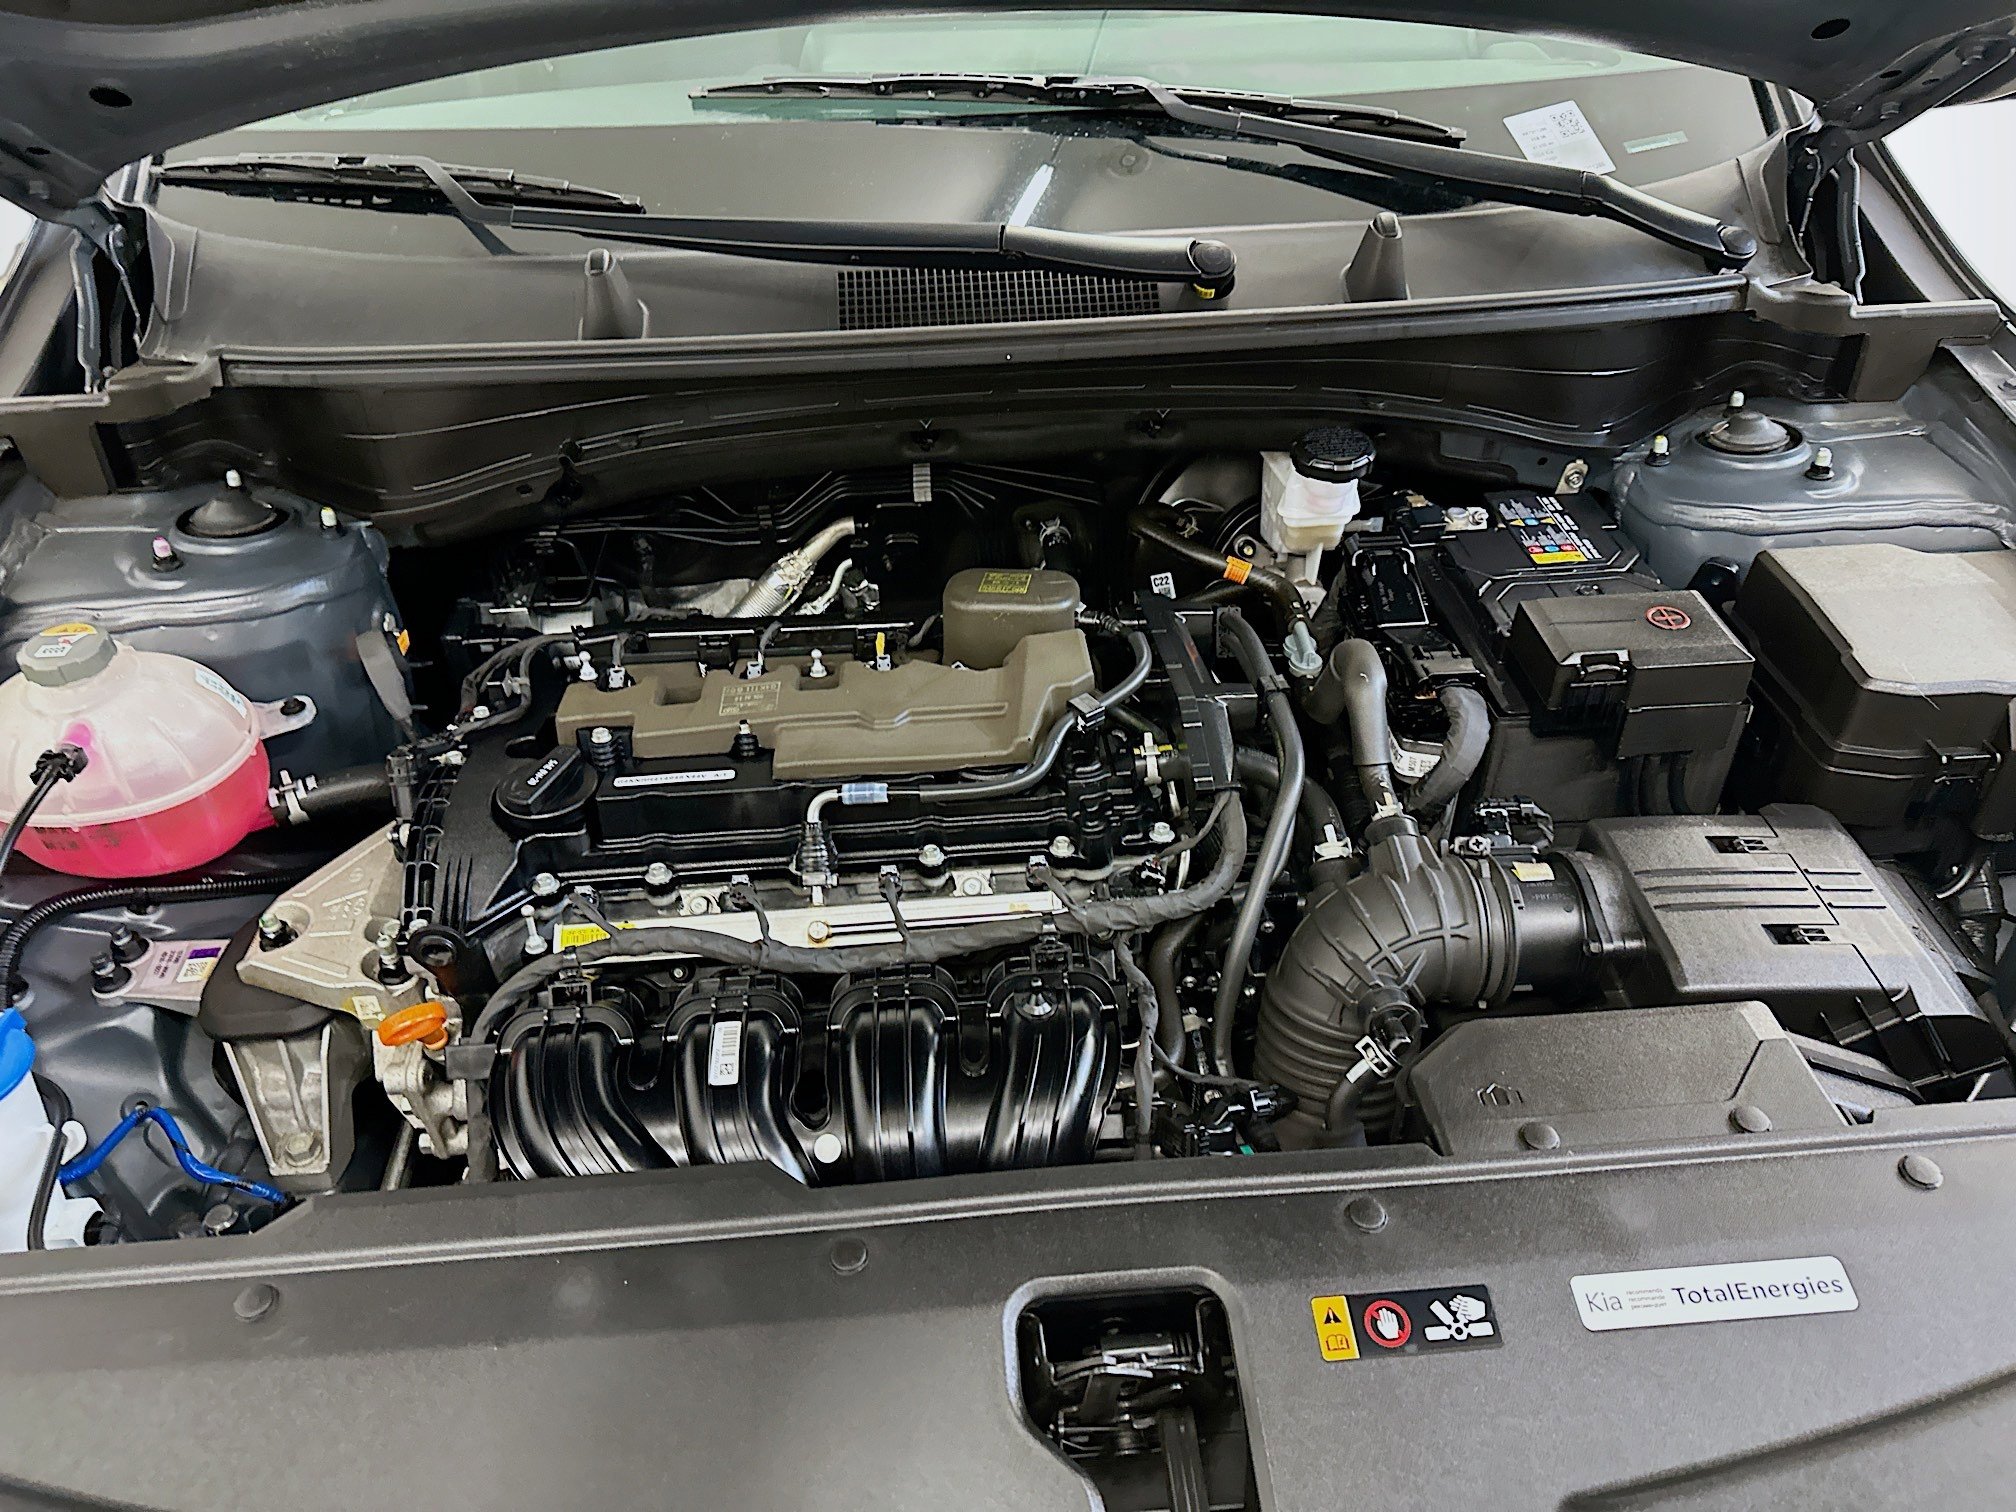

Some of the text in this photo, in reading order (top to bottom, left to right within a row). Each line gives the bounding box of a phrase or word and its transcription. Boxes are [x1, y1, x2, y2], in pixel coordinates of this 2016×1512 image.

[1153, 576, 1170, 587] C22
[1585, 1291, 1623, 1313] Kia
[1671, 1276, 1844, 1306] TotalEnergies
